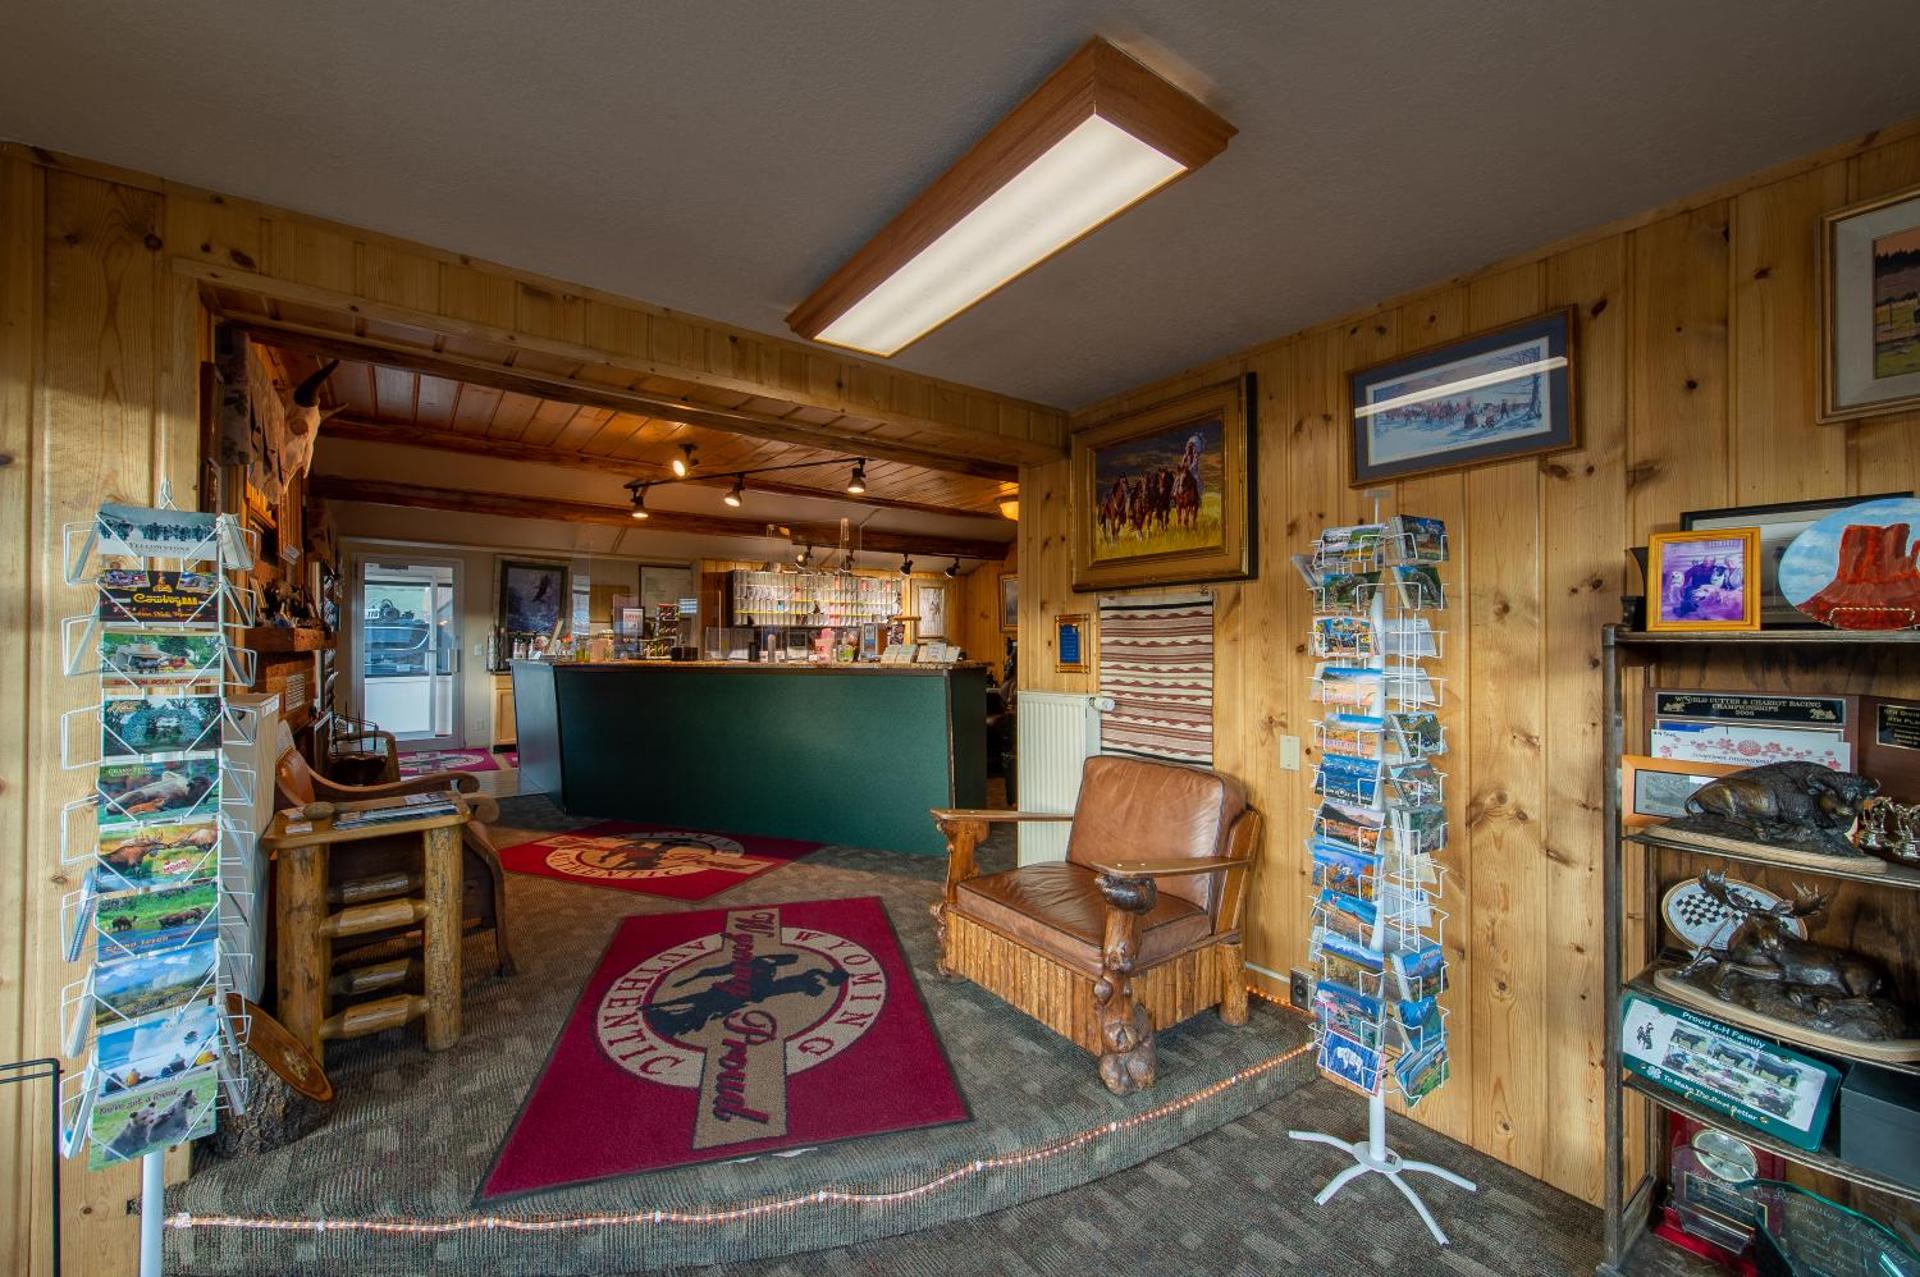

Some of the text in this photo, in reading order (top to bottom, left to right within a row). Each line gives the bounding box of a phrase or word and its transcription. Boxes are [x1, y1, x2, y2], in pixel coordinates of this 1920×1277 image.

[1675, 695, 1708, 705] WORLD
[1709, 697, 1741, 705] CUTTER
[1750, 699, 1787, 707] CHARIOT
[602, 940, 707, 1077] AUTHENTIC
[794, 930, 884, 1057] WYOMING
[1682, 1011, 1711, 1028] Proud
[1712, 1022, 1731, 1035] 4-H
[1731, 1027, 1766, 1049] Family
[713, 1009, 779, 1125] Proud
[1664, 1074, 1674, 1084] To
